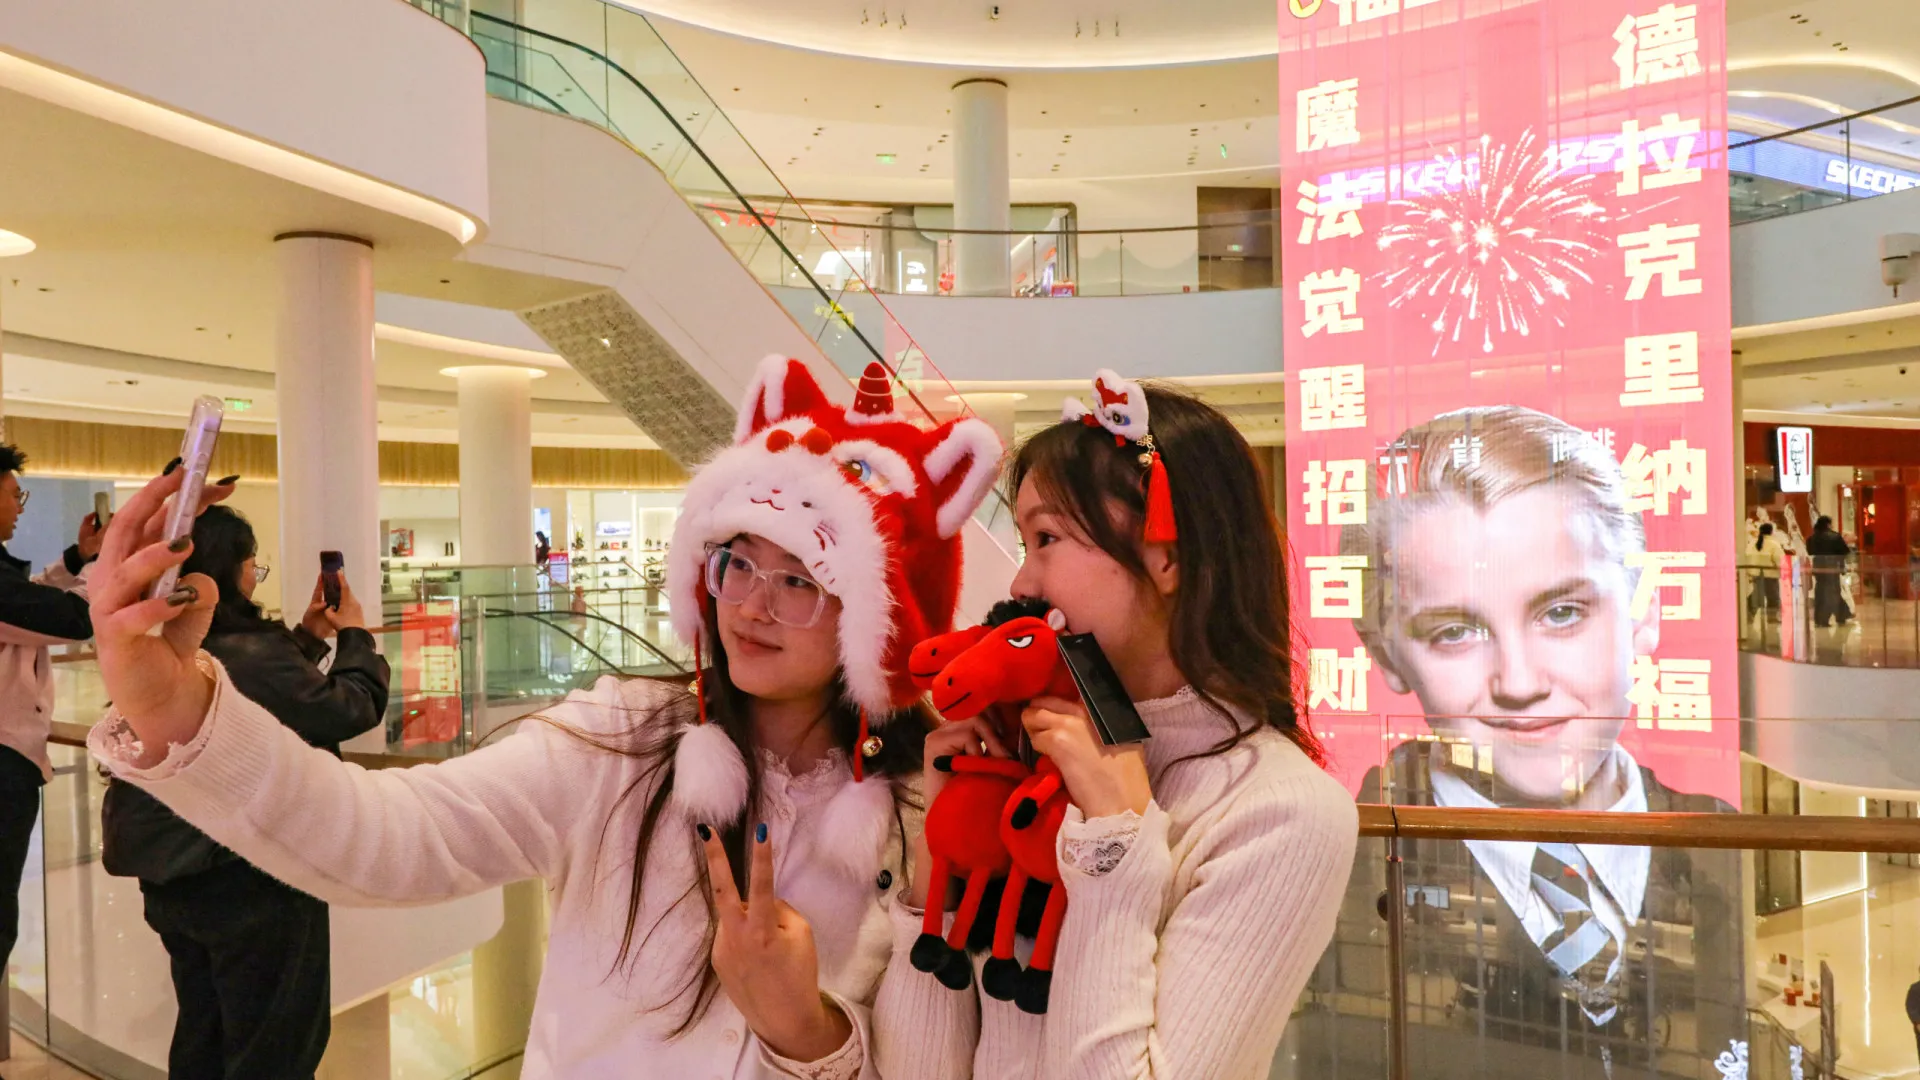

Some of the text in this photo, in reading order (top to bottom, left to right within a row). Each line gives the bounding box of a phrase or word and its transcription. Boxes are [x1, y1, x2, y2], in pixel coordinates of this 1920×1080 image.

[1296, 77, 1371, 712] 魔法觉醒招百财
[1612, 3, 1712, 733] 德拉克里纳万福
[1825, 159, 1920, 194] SKECHE
